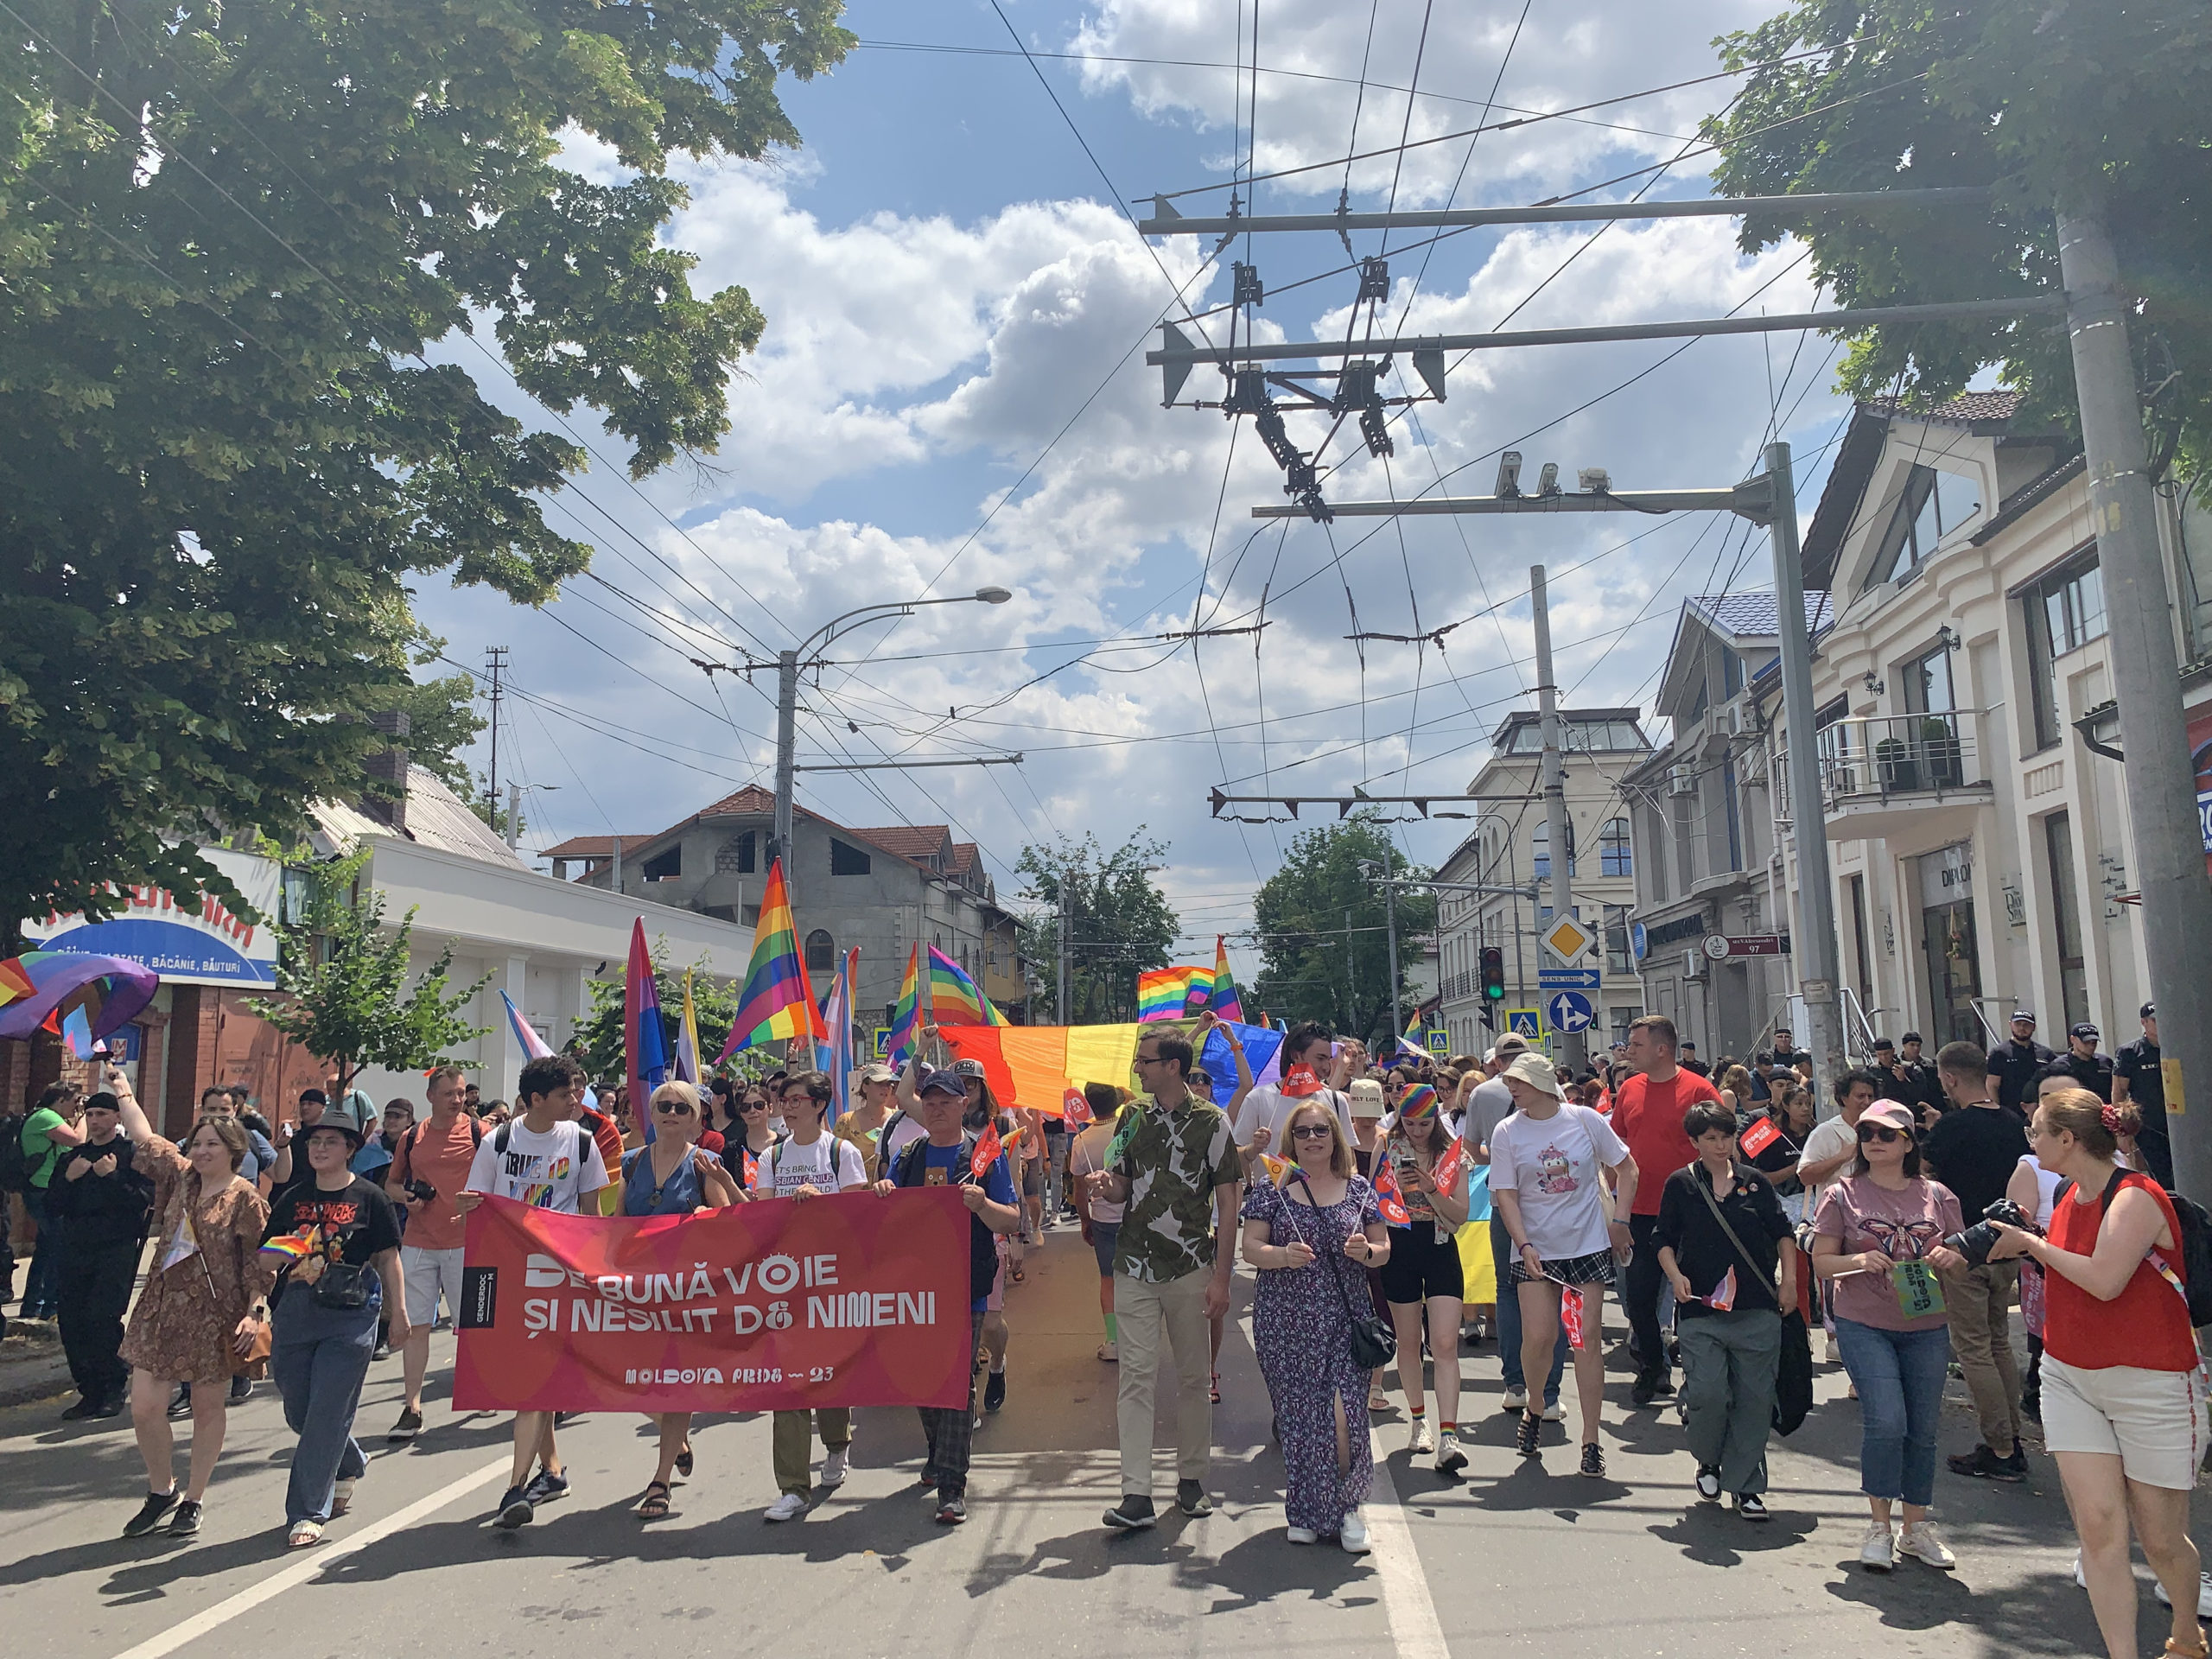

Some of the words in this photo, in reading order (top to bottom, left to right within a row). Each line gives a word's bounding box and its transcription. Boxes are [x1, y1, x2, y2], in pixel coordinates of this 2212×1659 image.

[1749, 945, 1760, 954] 97
[505, 1150, 543, 1179] TRUE
[547, 1155, 570, 1180] TO
[791, 1165, 817, 1173] BRING
[776, 1176, 802, 1185] SBIAN
[803, 1174, 833, 1185] GENIUS
[509, 1180, 554, 1208] YOUR
[524, 1253, 591, 1290] DE
[597, 1261, 718, 1305] BUNĂ
[722, 1251, 839, 1295] VOIE
[476, 1274, 486, 1323] GENDERDOC
[524, 1299, 559, 1339] ȘI
[570, 1299, 718, 1333] NESILIT
[807, 1291, 936, 1330] NIMENI
[625, 1367, 725, 1385] MOLDOVA
[732, 1367, 783, 1384] PRIDE
[809, 1366, 835, 1383] 23
